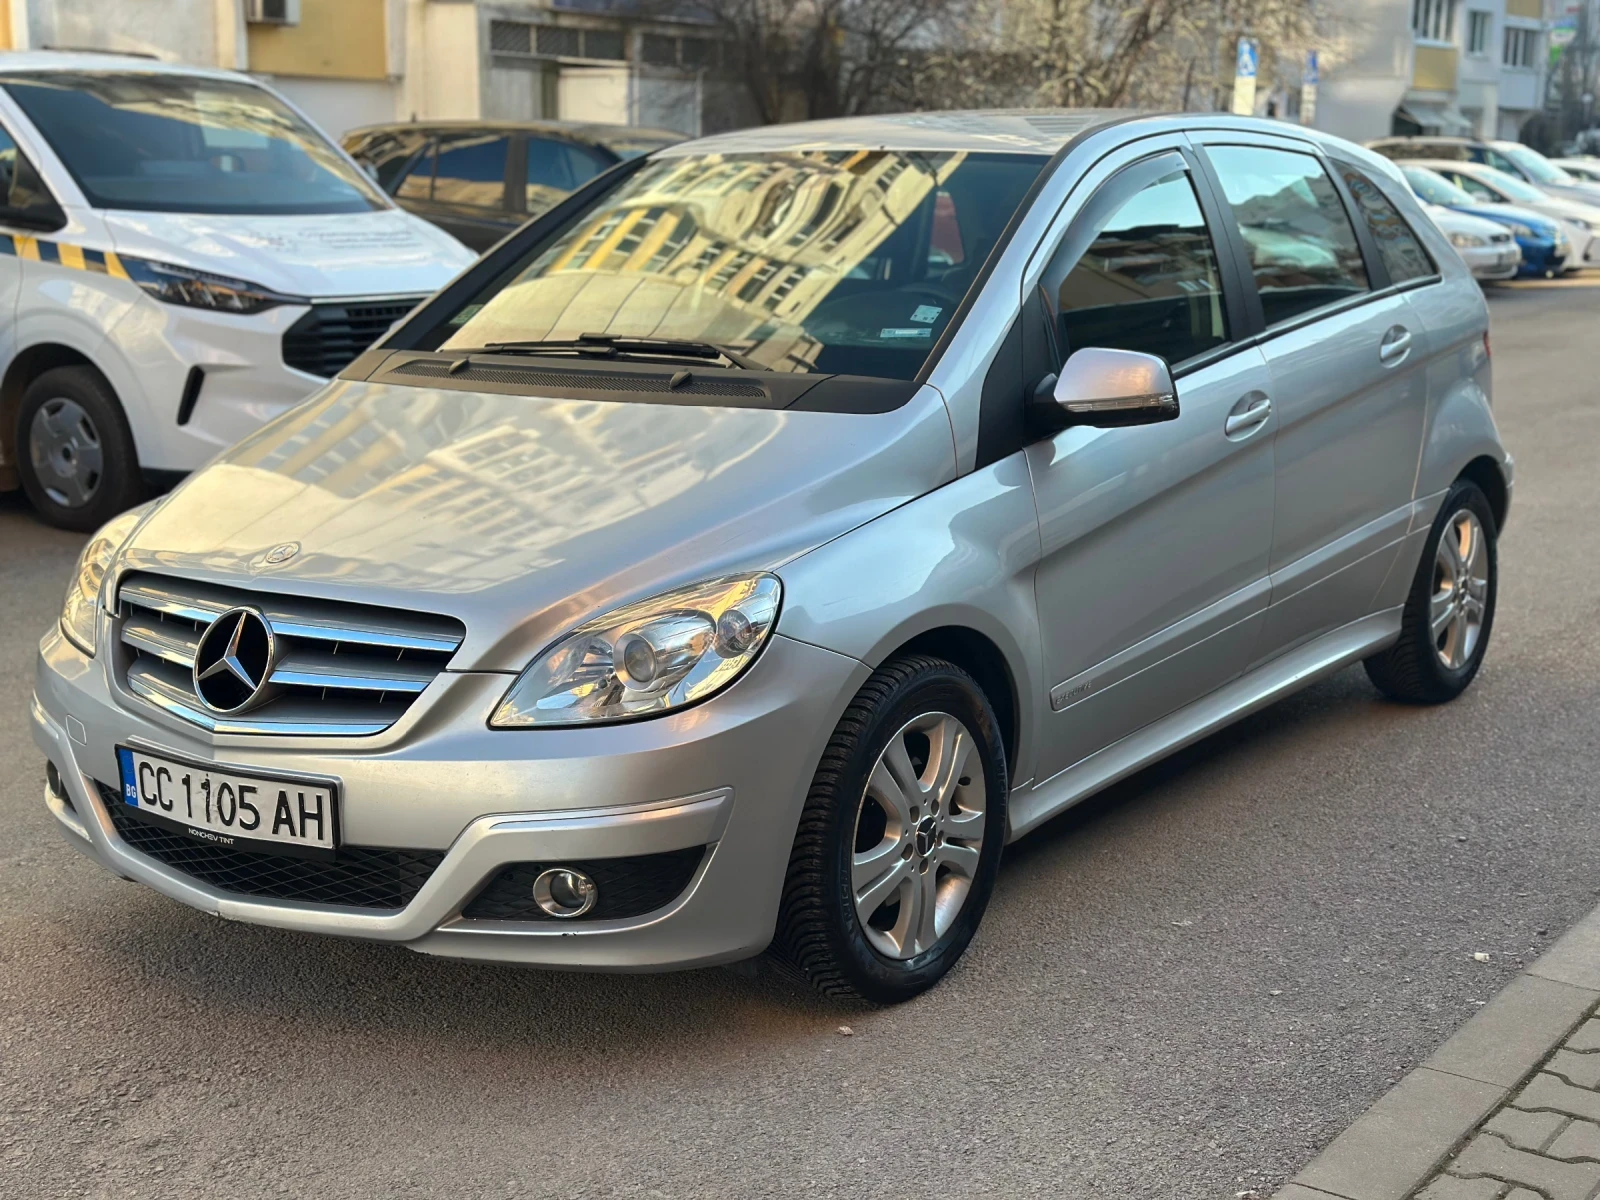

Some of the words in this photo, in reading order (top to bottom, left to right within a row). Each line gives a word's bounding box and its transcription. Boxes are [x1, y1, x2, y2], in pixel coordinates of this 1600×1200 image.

[126, 783, 137, 799] BG
[138, 761, 173, 811] CC
[181, 773, 261, 831] 1105
[271, 790, 324, 841] AH
[188, 828, 218, 842] NONCHEV
[218, 836, 235, 845] TINT
